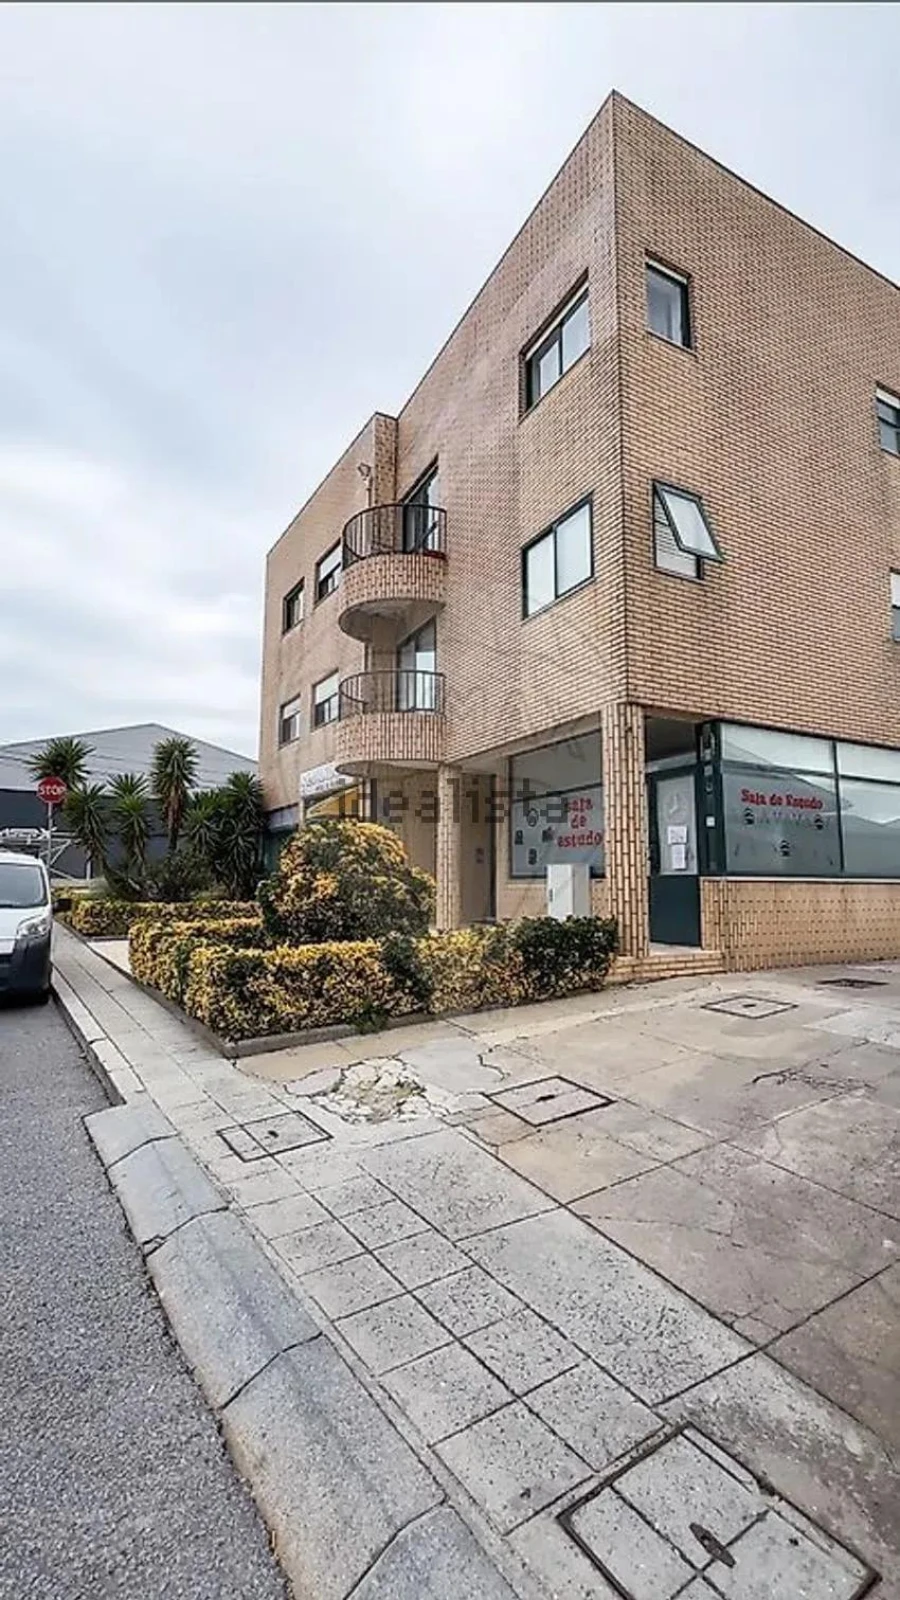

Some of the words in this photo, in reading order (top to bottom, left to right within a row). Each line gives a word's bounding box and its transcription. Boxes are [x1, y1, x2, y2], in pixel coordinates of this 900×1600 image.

[39, 785, 66, 796] STOP
[741, 788, 767, 806] Sala
[570, 814, 587, 829] de
[557, 830, 603, 848] estudo
